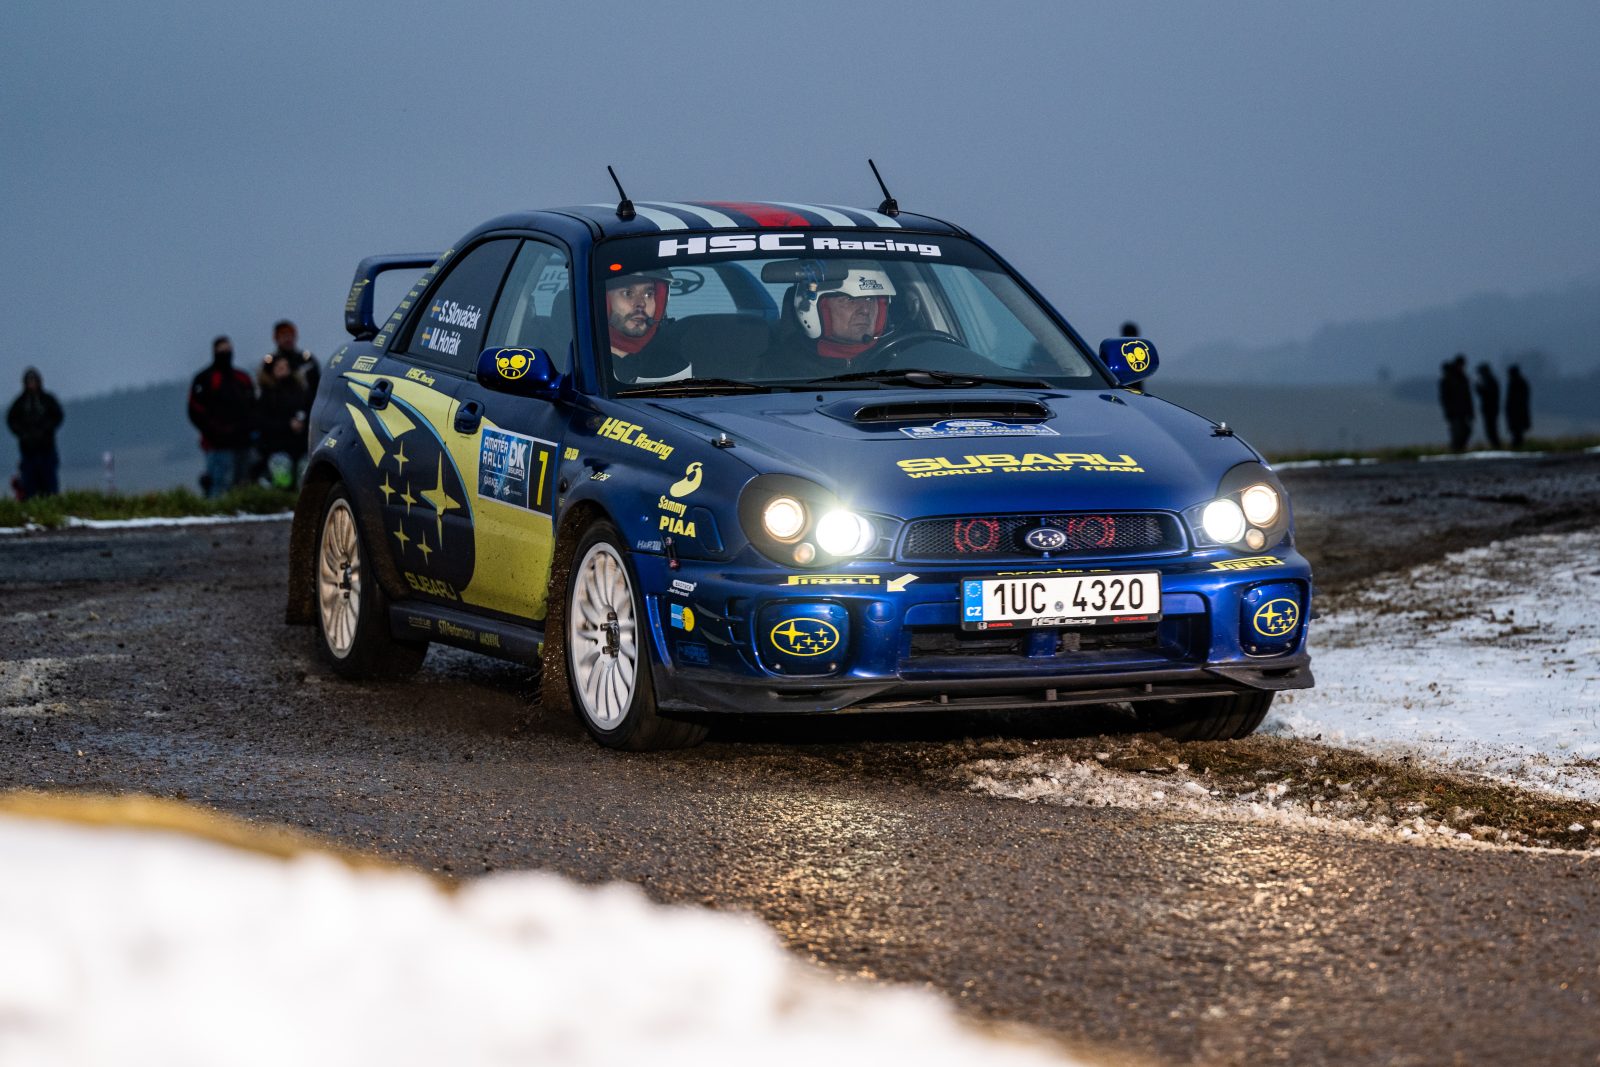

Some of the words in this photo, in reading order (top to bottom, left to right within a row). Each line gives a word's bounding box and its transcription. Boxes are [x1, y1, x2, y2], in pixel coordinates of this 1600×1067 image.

[658, 233, 806, 257] HSC
[812, 237, 942, 257] Racing
[596, 416, 644, 445] HSC
[632, 432, 675, 461] Racing
[482, 451, 507, 470] RALLY
[896, 453, 1138, 472] SUBARU
[907, 467, 993, 479] WORLD
[658, 495, 687, 517] Sammy
[659, 516, 696, 538] PIAA
[1210, 555, 1285, 571] PIRELLI
[404, 572, 457, 601] SUBARU
[787, 574, 881, 585] PIRELLI
[994, 582, 1046, 615] 1UC
[1072, 577, 1144, 612] 4320
[966, 605, 982, 617] CZ
[1031, 616, 1065, 627] HSC
